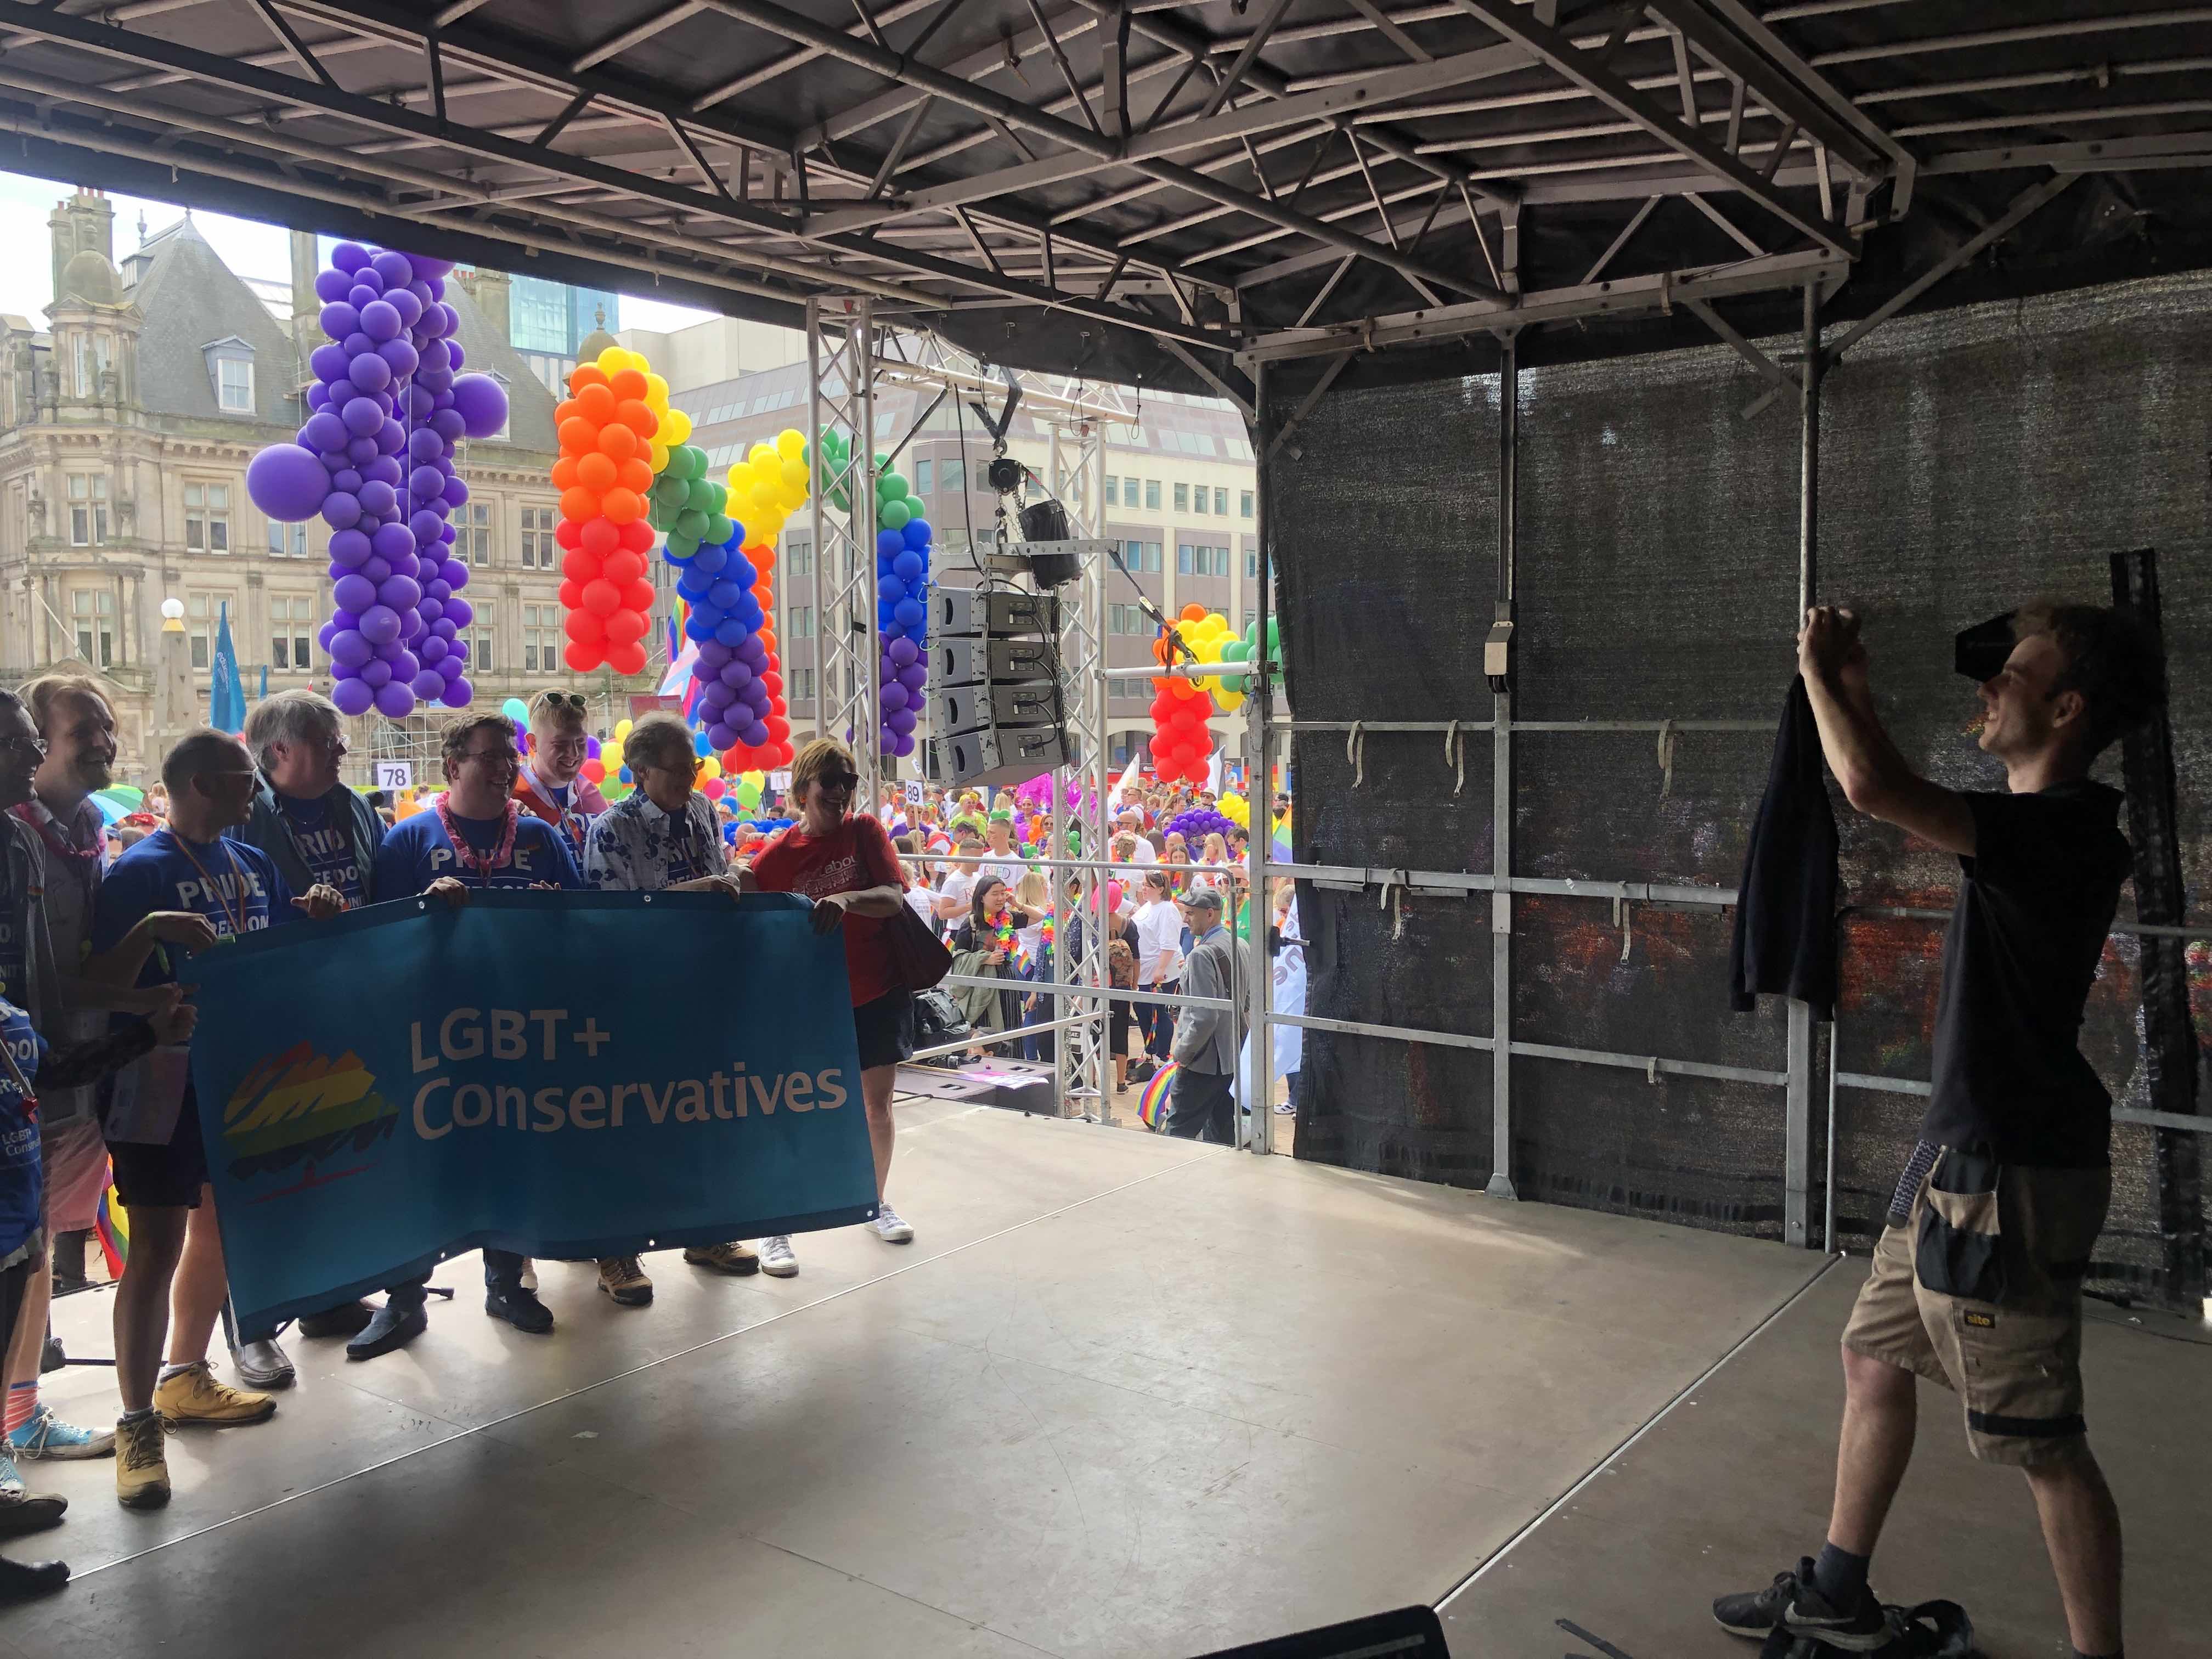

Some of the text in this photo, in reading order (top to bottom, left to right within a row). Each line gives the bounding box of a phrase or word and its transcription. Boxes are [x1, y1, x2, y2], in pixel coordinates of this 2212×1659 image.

[383, 769, 406, 786] 78
[907, 785, 919, 802] 89
[410, 1008, 610, 1073] LGBT+
[413, 1062, 847, 1140] Conservatives
[1967, 1314, 1991, 1326] site
